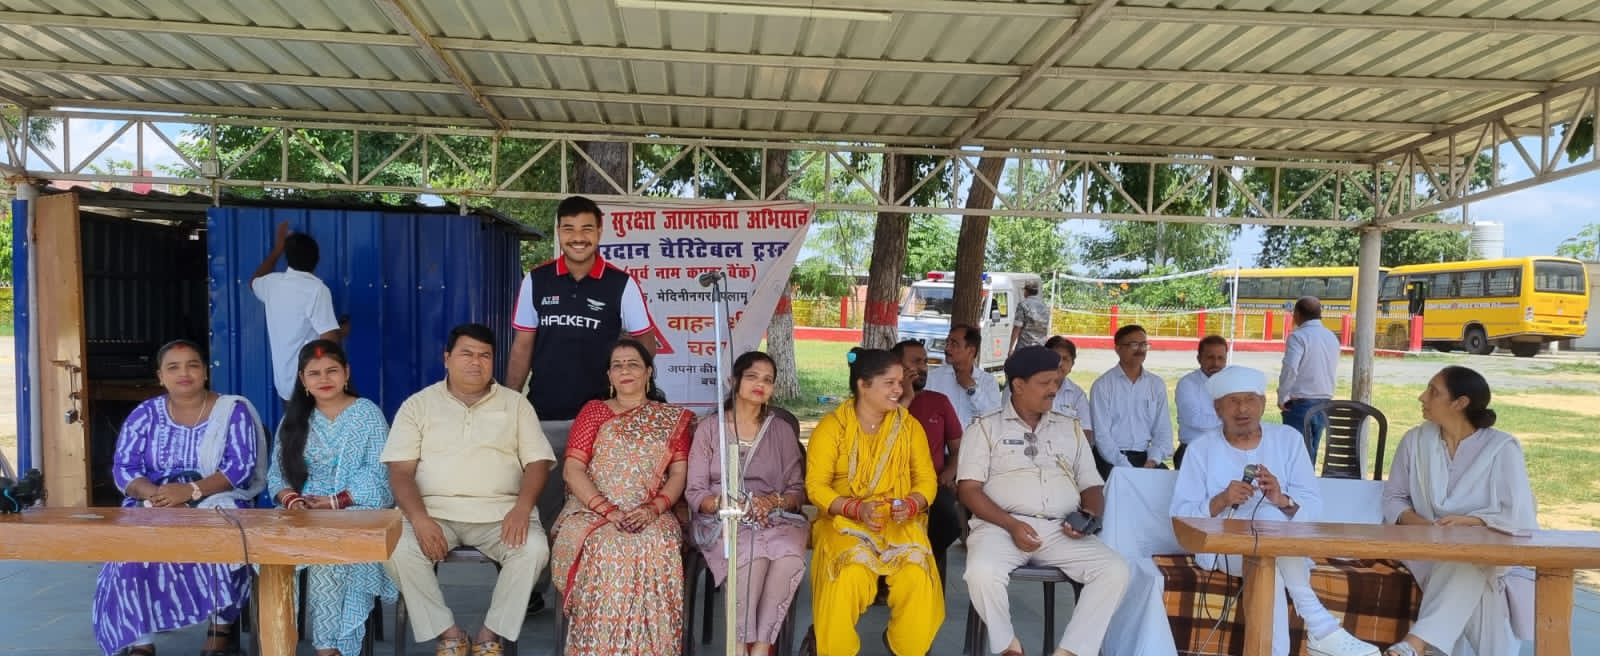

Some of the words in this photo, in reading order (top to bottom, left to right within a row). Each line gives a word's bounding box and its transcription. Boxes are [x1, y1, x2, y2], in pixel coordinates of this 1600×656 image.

[611, 211, 656, 237] सुरक्षा
[747, 208, 809, 229] अभियान
[597, 243, 651, 260] रदान
[659, 237, 743, 259] चैरिटेबल
[655, 267, 682, 279] नाम
[541, 314, 601, 330] HACKETT
[668, 365, 697, 374] अपना
